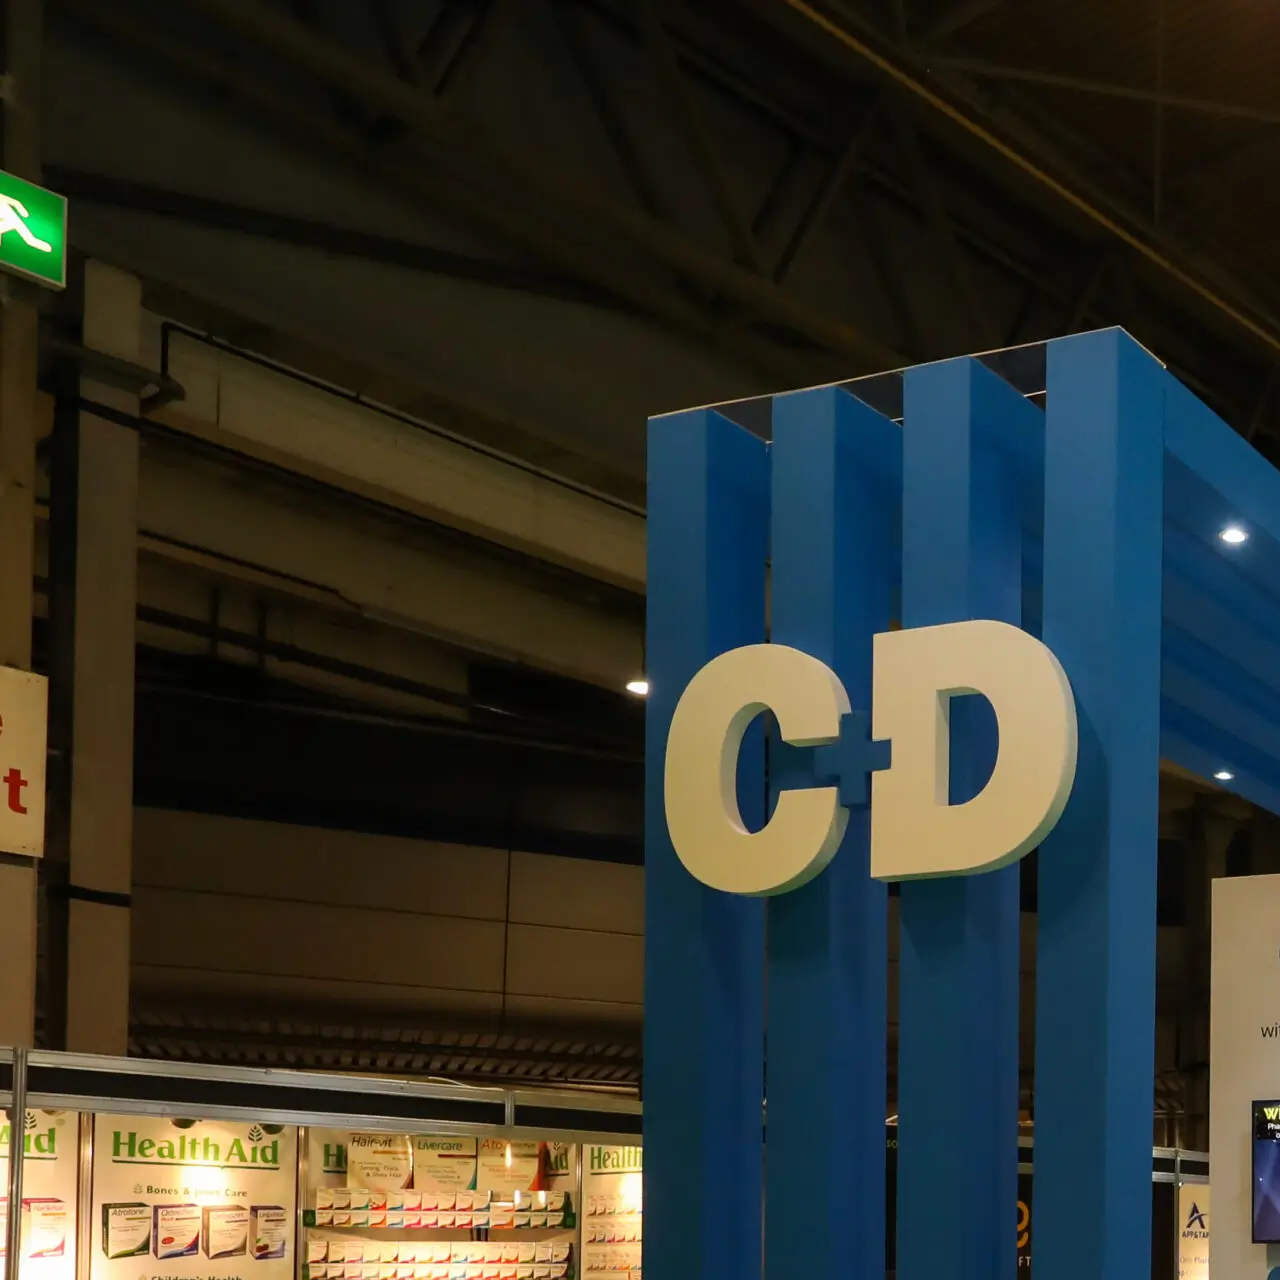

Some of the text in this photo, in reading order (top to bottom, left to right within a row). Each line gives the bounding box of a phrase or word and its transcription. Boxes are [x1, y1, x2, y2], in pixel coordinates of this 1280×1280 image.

[664, 618, 1078, 897] C+D
[417, 1140, 463, 1151] Livercare
[146, 1186, 178, 1195] Bones
[225, 1188, 248, 1198] Care
